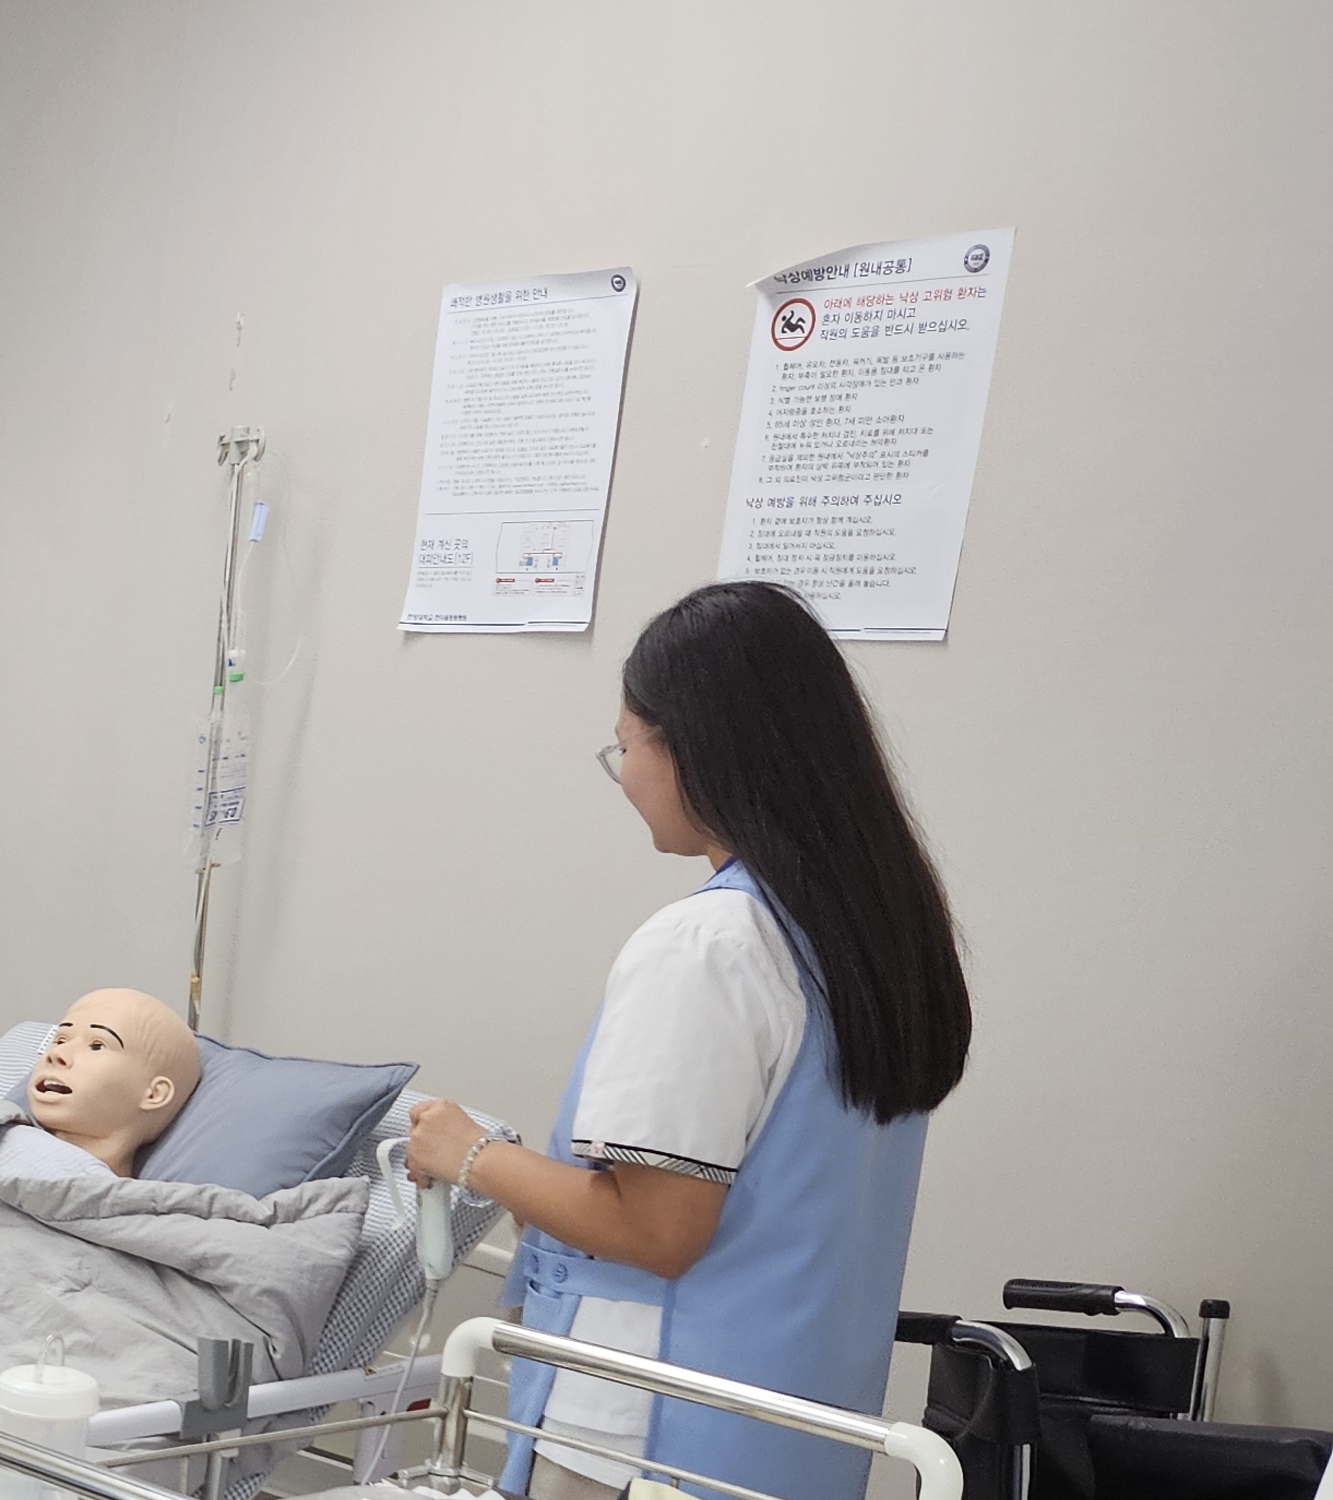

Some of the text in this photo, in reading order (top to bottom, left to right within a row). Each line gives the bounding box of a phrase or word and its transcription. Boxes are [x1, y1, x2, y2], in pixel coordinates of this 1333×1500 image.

[853, 257, 913, 279] [원내공통]
[532, 286, 549, 301] 안내
[823, 286, 988, 310] 아래에 해당하는 낙상 고위험 환자는
[822, 307, 917, 326] 혼자 이동하지 마시고
[820, 327, 848, 341] 직원의
[851, 324, 880, 339] 도움을
[884, 321, 915, 336] 반드시
[745, 493, 902, 510] 낙상 예방을 위해 주의하여 주십시오
